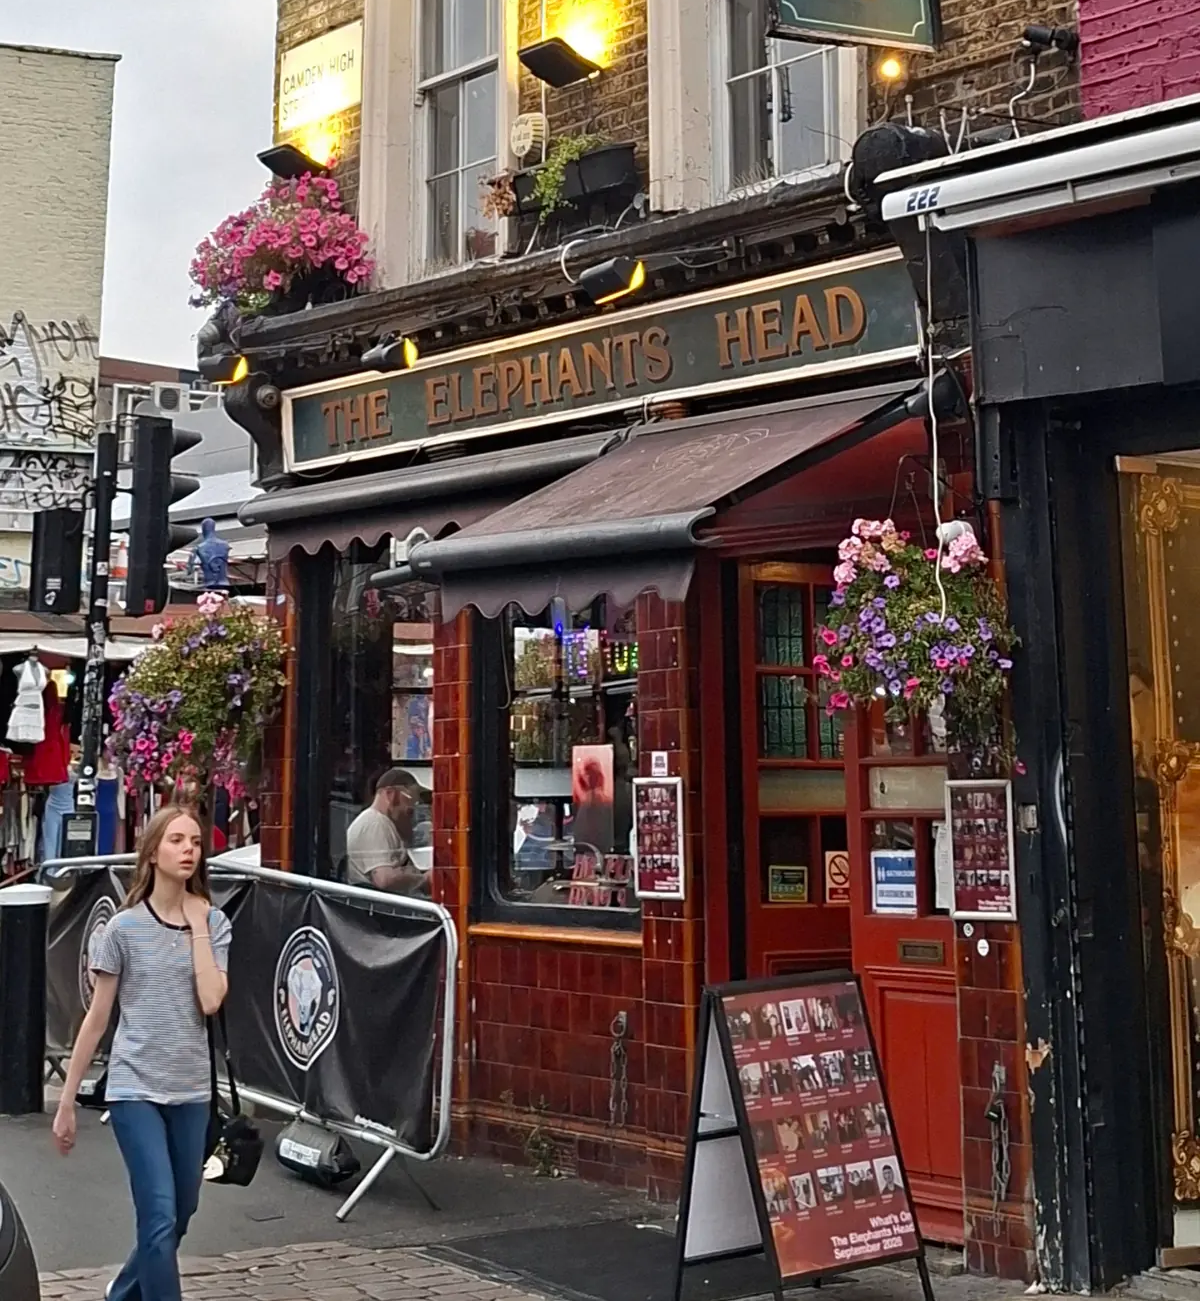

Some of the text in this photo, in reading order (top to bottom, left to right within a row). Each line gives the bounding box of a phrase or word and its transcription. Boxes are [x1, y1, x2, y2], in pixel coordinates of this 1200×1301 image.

[282, 48, 355, 96] CAMDEN HIGH
[906, 186, 941, 212] 222
[321, 285, 867, 448] THE ELEPHANTS HEAD
[869, 1214, 899, 1228] What's
[830, 1223, 915, 1247] The Elephants Head
[834, 1242, 880, 1259] September
